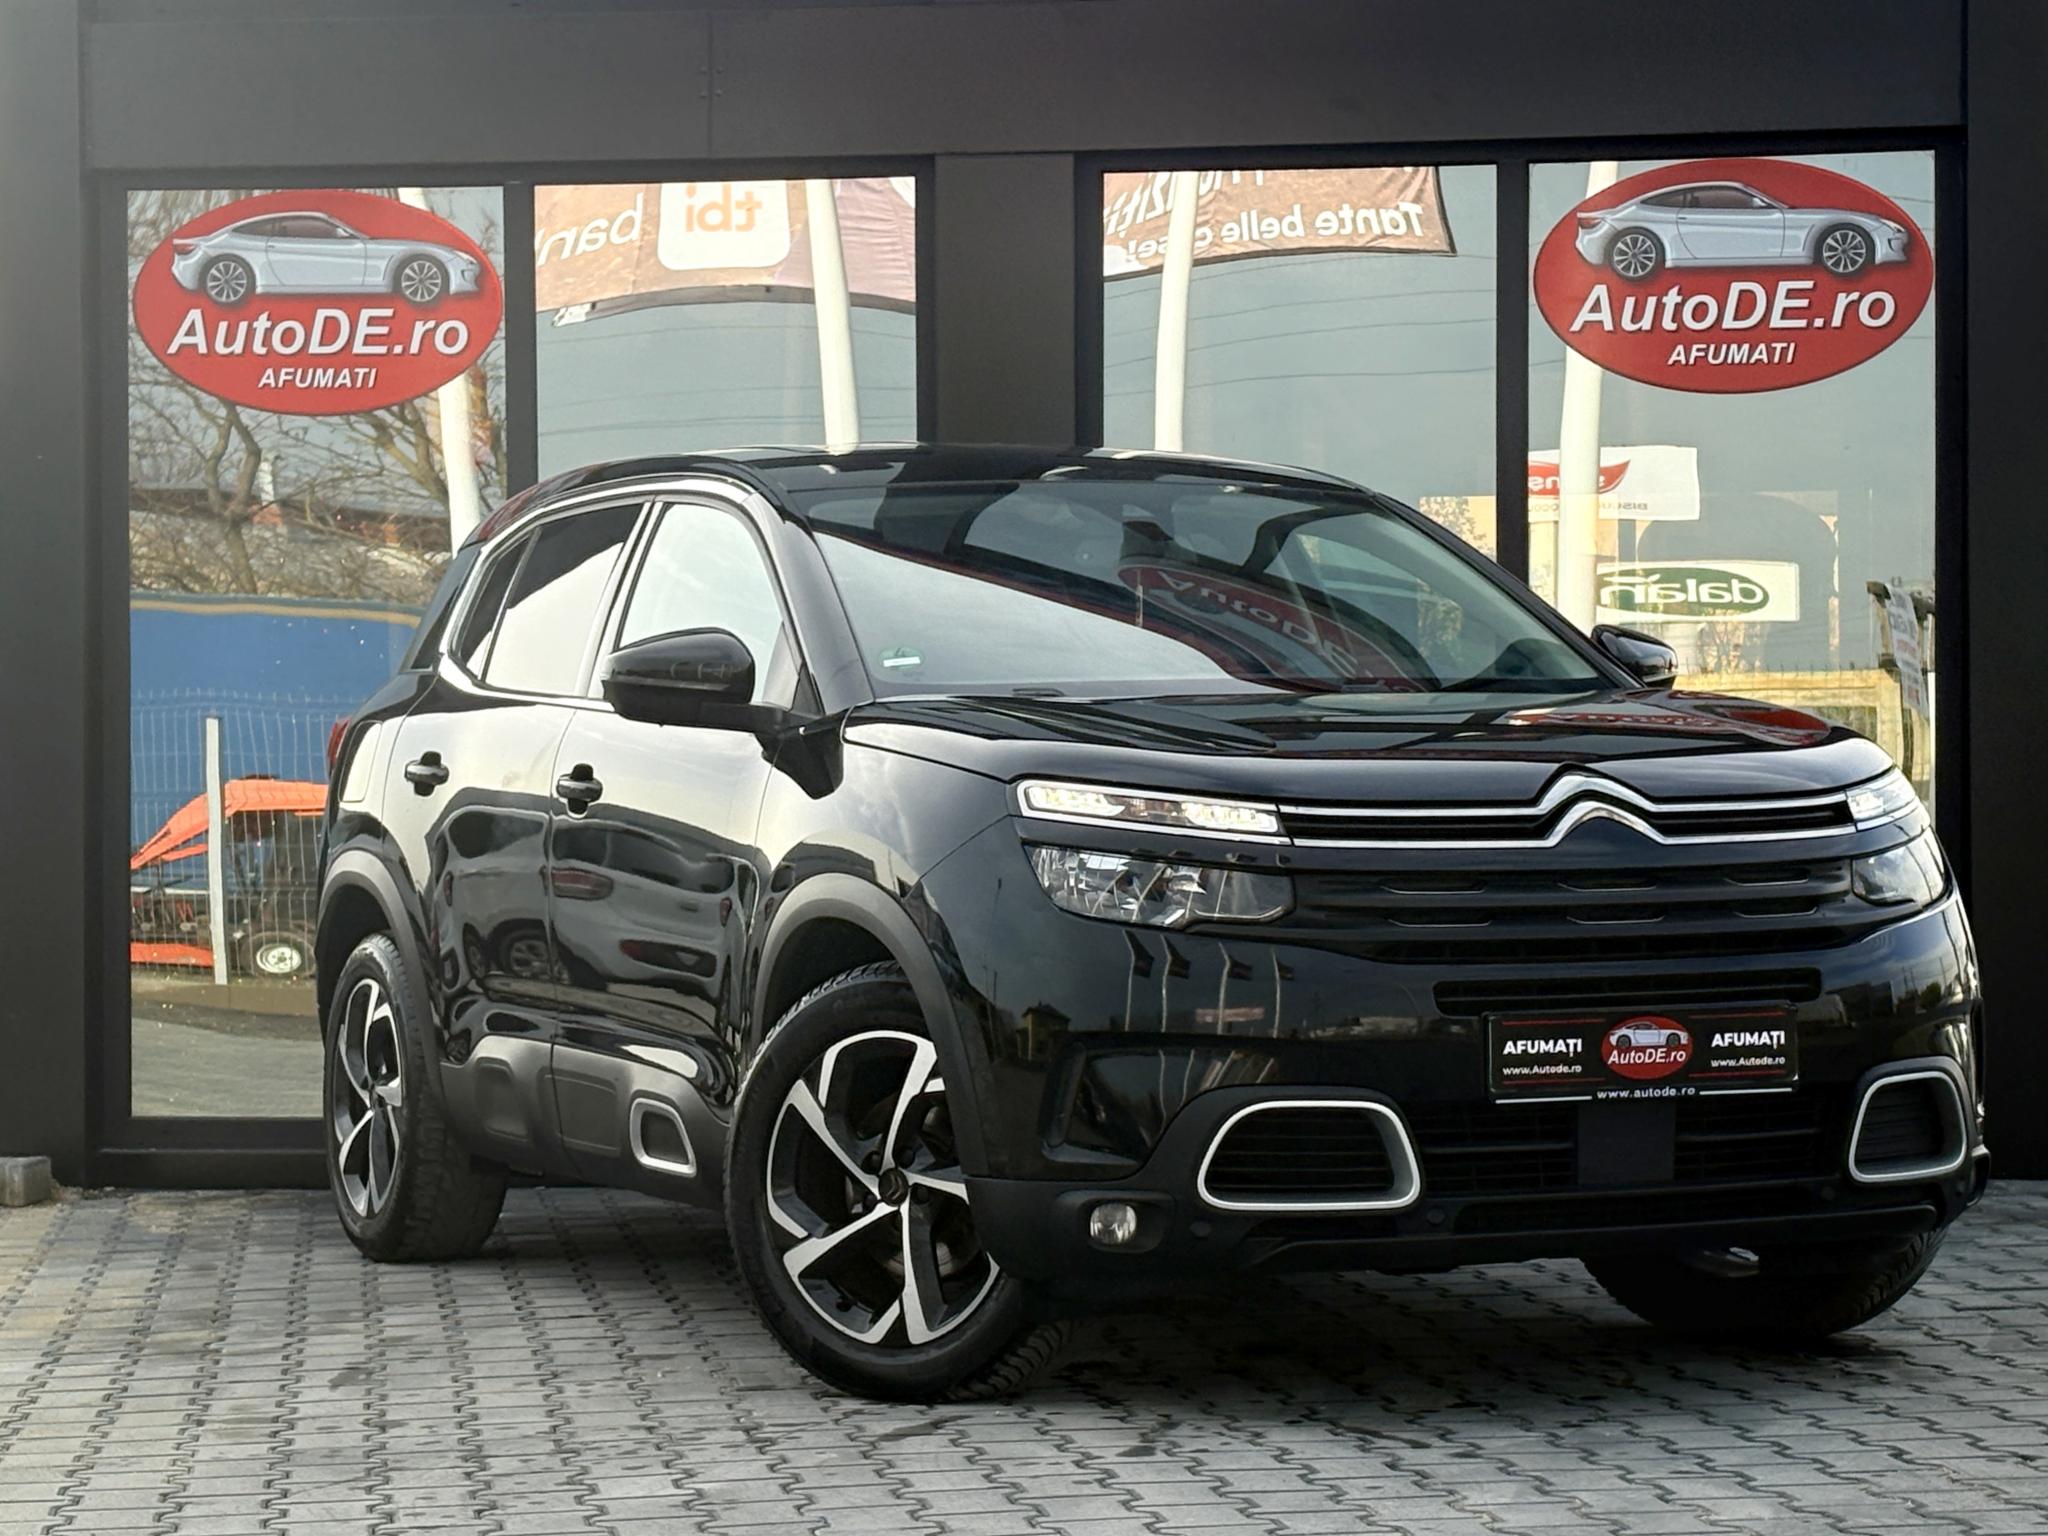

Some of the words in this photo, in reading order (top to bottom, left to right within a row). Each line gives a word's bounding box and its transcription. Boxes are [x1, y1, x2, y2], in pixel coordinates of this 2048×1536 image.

[1569, 279, 1896, 333] AutoDE.ro
[166, 307, 470, 356] AutoDE.ro
[1667, 342, 1796, 366] AFUMATI
[257, 366, 377, 390] AFUMATI
[1607, 1048, 1687, 1066] AutoDE.ro
[1597, 1086, 1696, 1100] www.autode.ro
